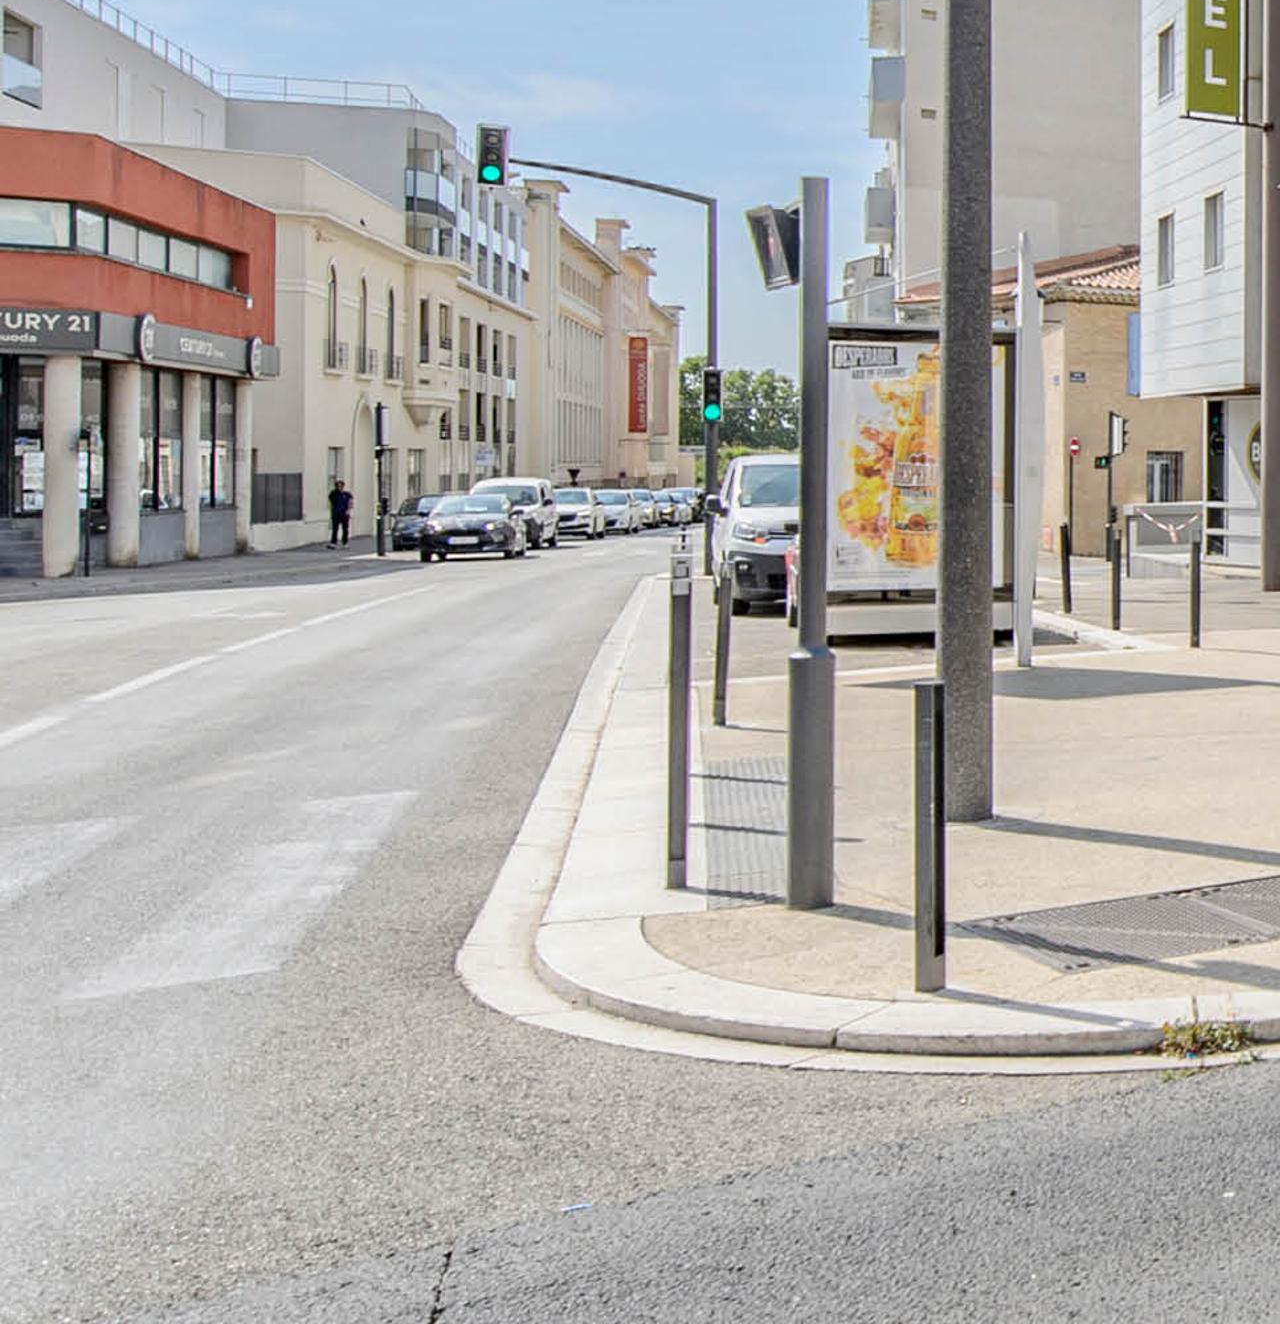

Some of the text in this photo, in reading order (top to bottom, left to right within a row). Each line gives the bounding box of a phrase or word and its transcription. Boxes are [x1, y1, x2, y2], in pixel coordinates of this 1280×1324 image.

[0, 311, 91, 332] URY 21
[0, 332, 38, 343] uoda
